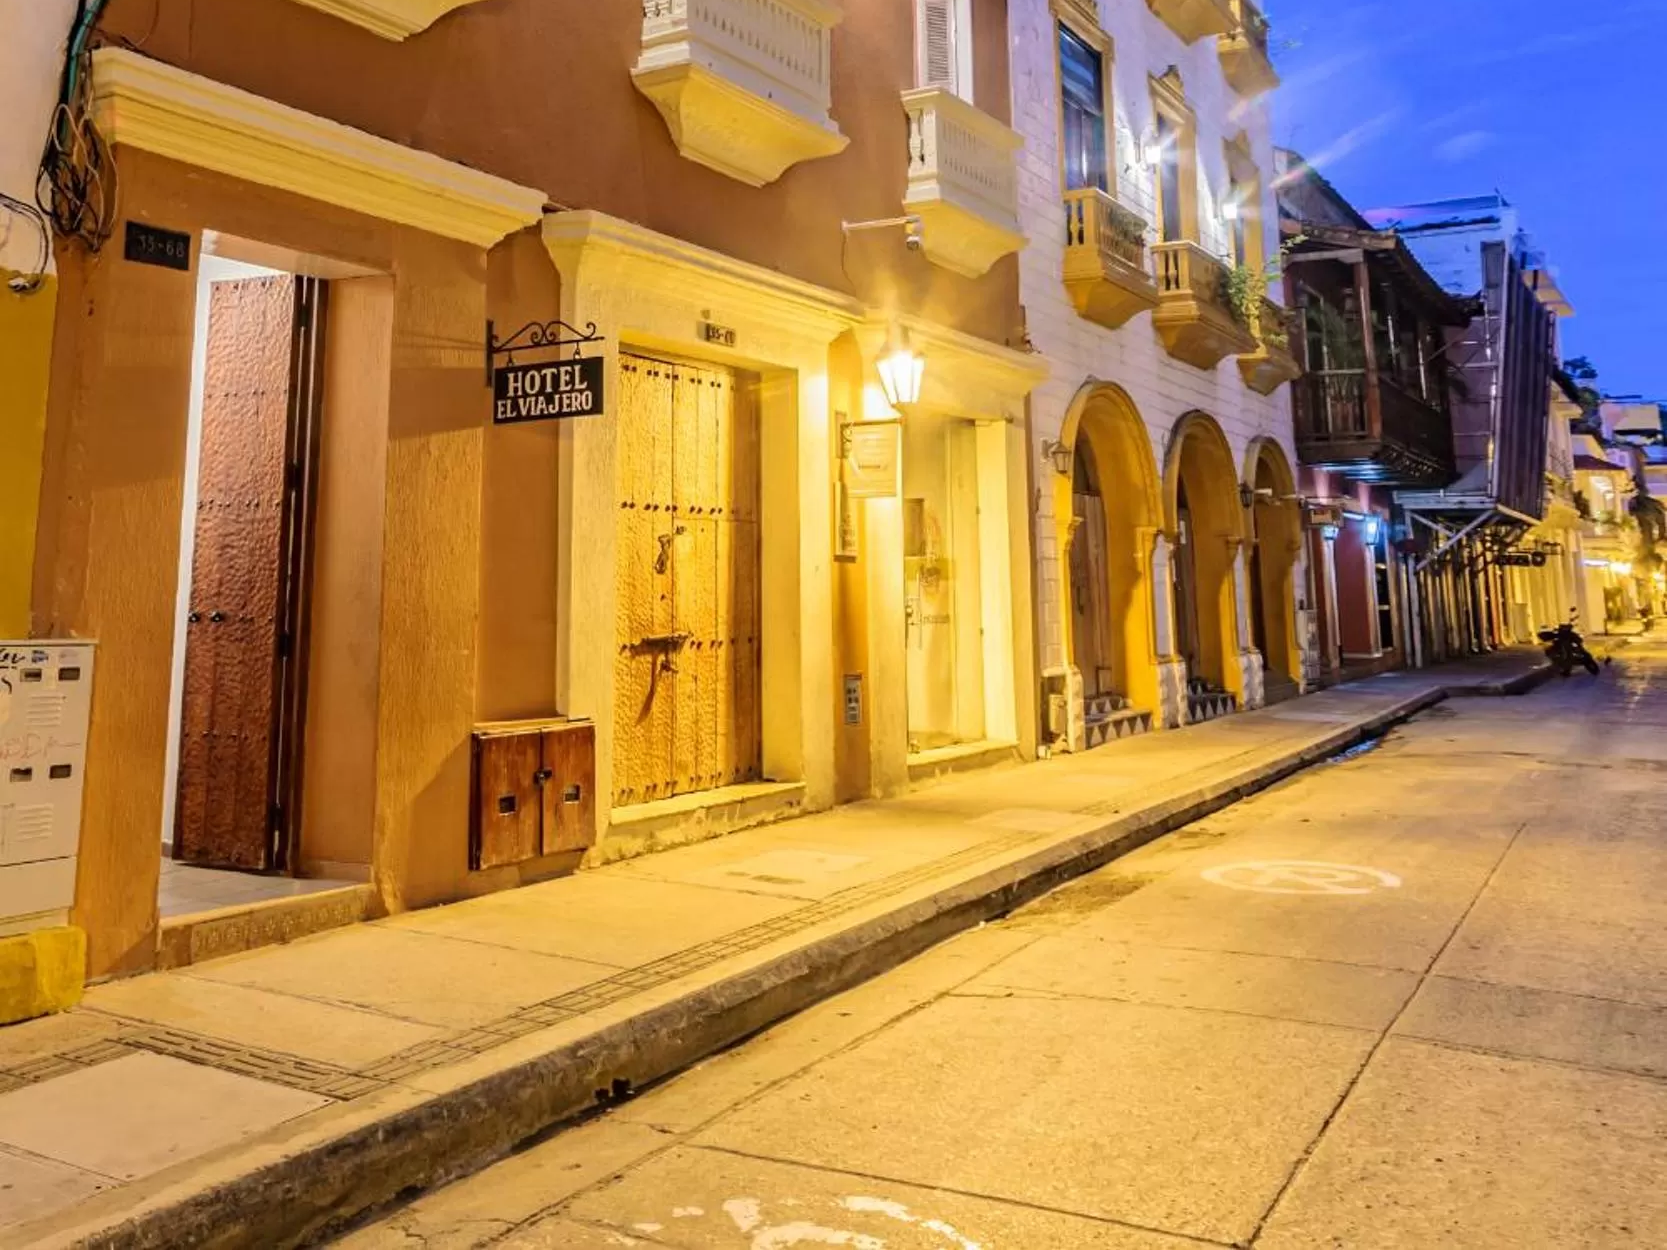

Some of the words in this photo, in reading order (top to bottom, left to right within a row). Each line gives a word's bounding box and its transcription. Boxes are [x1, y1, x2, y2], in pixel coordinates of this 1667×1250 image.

[506, 364, 588, 398] HOTEL
[496, 399, 517, 419] EL
[518, 390, 593, 417] VIAJERO
